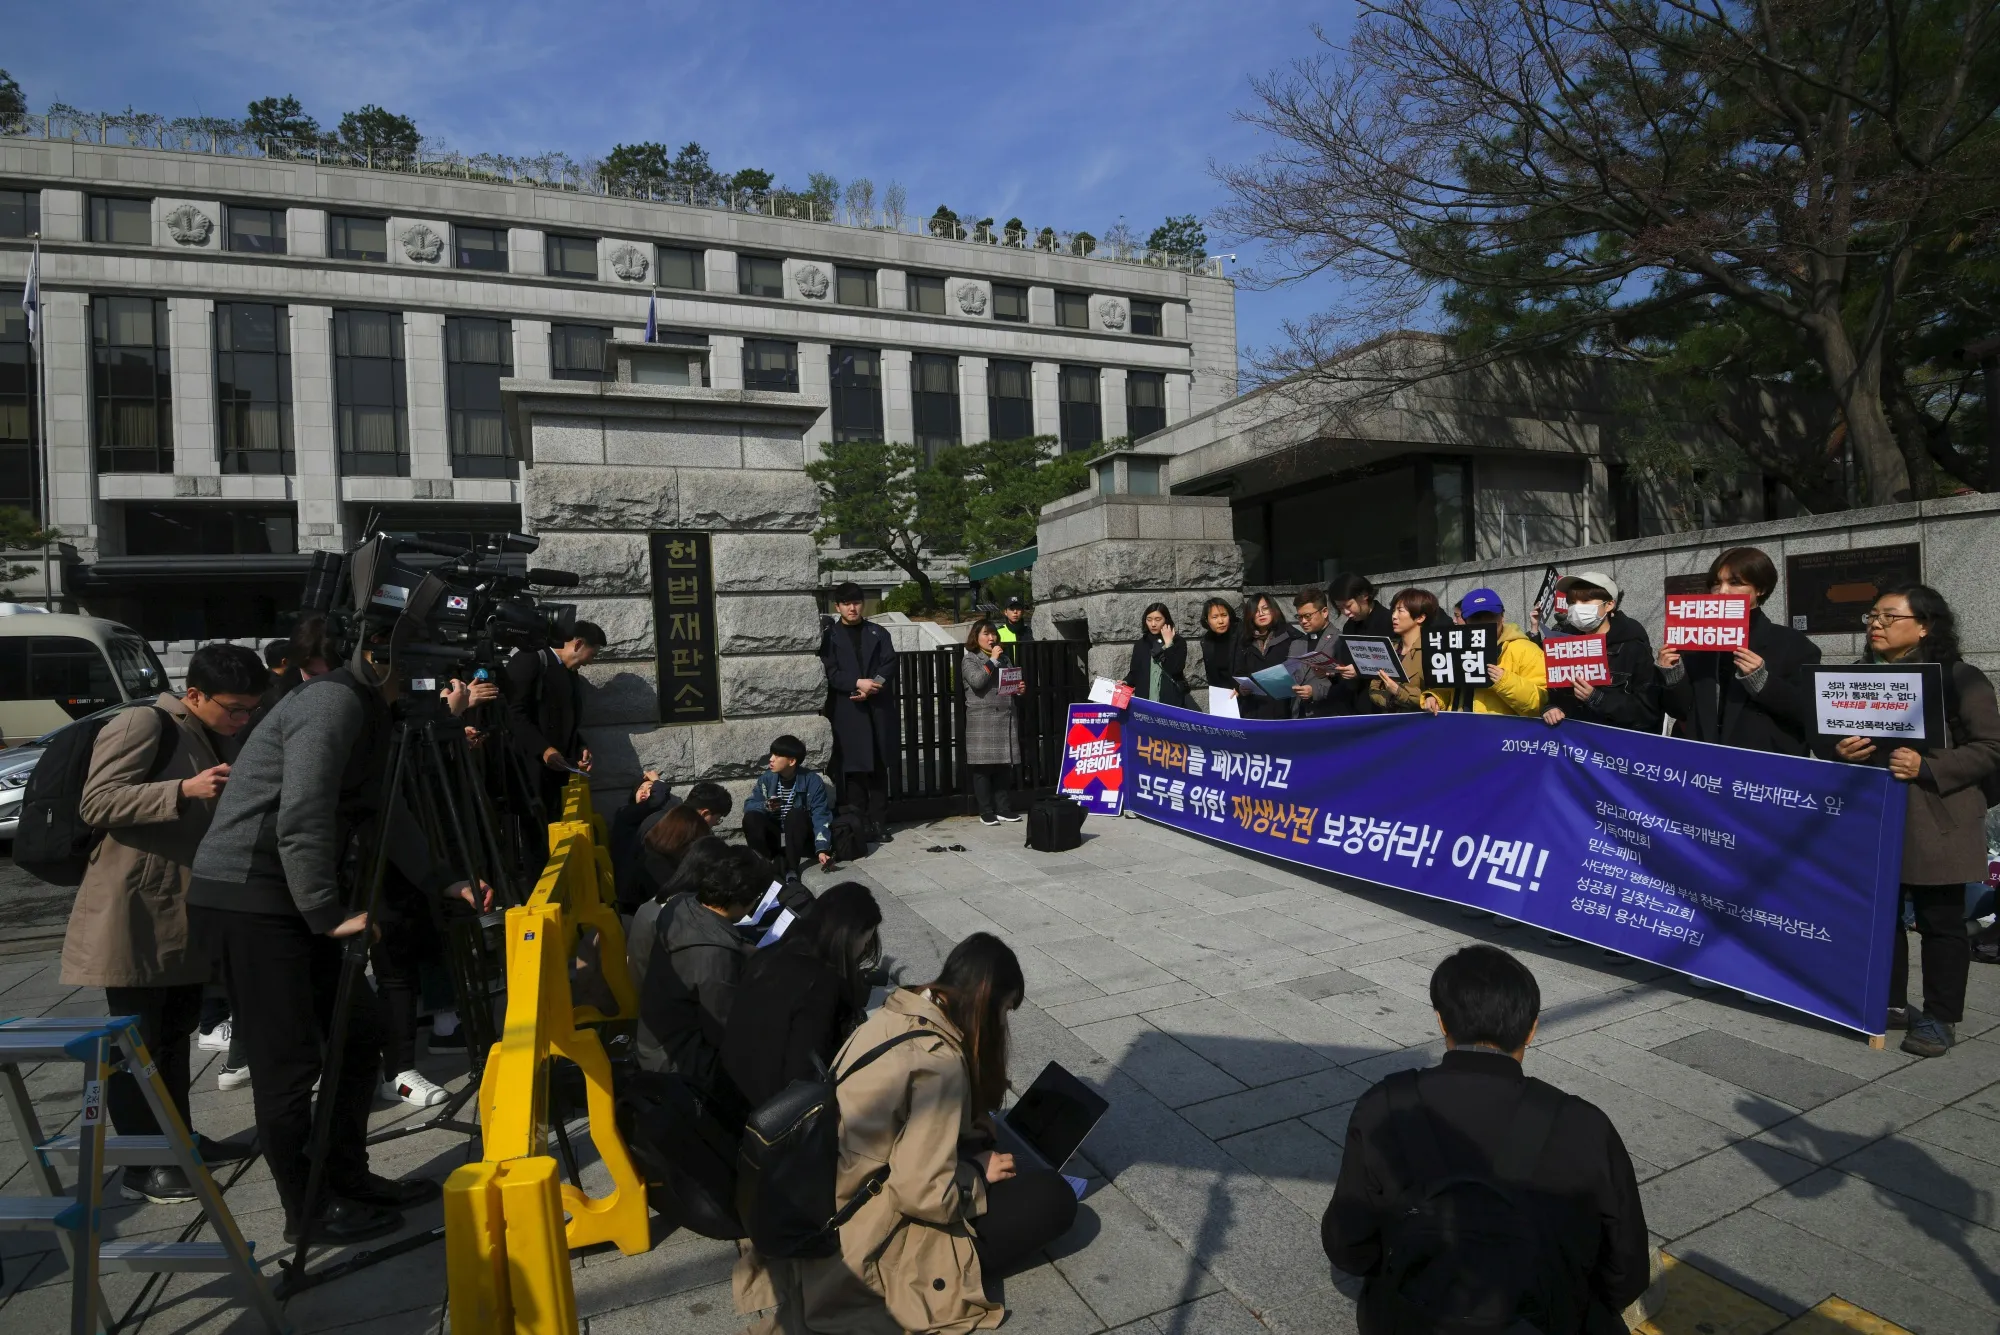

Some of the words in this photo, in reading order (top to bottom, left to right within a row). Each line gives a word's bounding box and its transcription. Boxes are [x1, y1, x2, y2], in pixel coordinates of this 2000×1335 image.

[1668, 600, 1745, 620] 낙태죄를
[665, 539, 704, 713] 헌법재판소
[1666, 626, 1745, 646] 폐지하라
[1428, 629, 1486, 650] 낙태죄
[1545, 638, 1603, 660] 낙태죄를
[1431, 650, 1486, 683] 위헌
[1547, 662, 1606, 682] 폐지하라
[1822, 692, 1848, 700] 국가가
[1852, 692, 1879, 700] 통제할
[1884, 692, 1894, 700] 수
[1898, 692, 1916, 702] 없다
[1828, 682, 1845, 690] 성과
[1849, 682, 1885, 690] 재생산의
[1890, 682, 1909, 692] 권리
[1831, 701, 1867, 710] 낙태죄를
[1870, 702, 1908, 710] 폐지하라
[1826, 718, 1916, 732] 천주교성폭력상담소
[1069, 740, 1115, 760] 낙태죄는
[1136, 736, 1206, 776] 낙태죄를
[1210, 750, 1292, 789] 폐지하고
[1075, 753, 1122, 776] 위헌이다
[1501, 739, 1539, 755] 2019년
[1540, 740, 1560, 757] 4월
[1562, 744, 1588, 764] 11일
[1591, 751, 1629, 774] 목요일
[1633, 761, 1661, 783] 오전
[1663, 768, 1687, 788] 9시
[1690, 774, 1722, 796] 40분
[1732, 780, 1818, 811] 헌법재판소
[1824, 796, 1844, 816] 앞
[1136, 774, 1186, 812] 모두를
[1190, 786, 1228, 824] 위한
[1231, 795, 1318, 844] 재생산권
[1318, 812, 1444, 868] 보장하라!
[1452, 834, 1550, 892] 아멘!
[1594, 820, 1651, 849] 기독여민회
[1595, 800, 1736, 850] 감리교여성지도력개발원
[1588, 838, 1642, 865] 믿는페미
[1576, 876, 1618, 900] 성공회
[1620, 887, 1696, 923] 길찾는교회
[1582, 858, 1628, 880] 사단법인
[1630, 871, 1676, 896] 평화의샘
[1700, 893, 1833, 942] 천주교성폭력상담소
[1571, 896, 1611, 919] 성공회
[1614, 908, 1704, 948] 용산나눔의집
